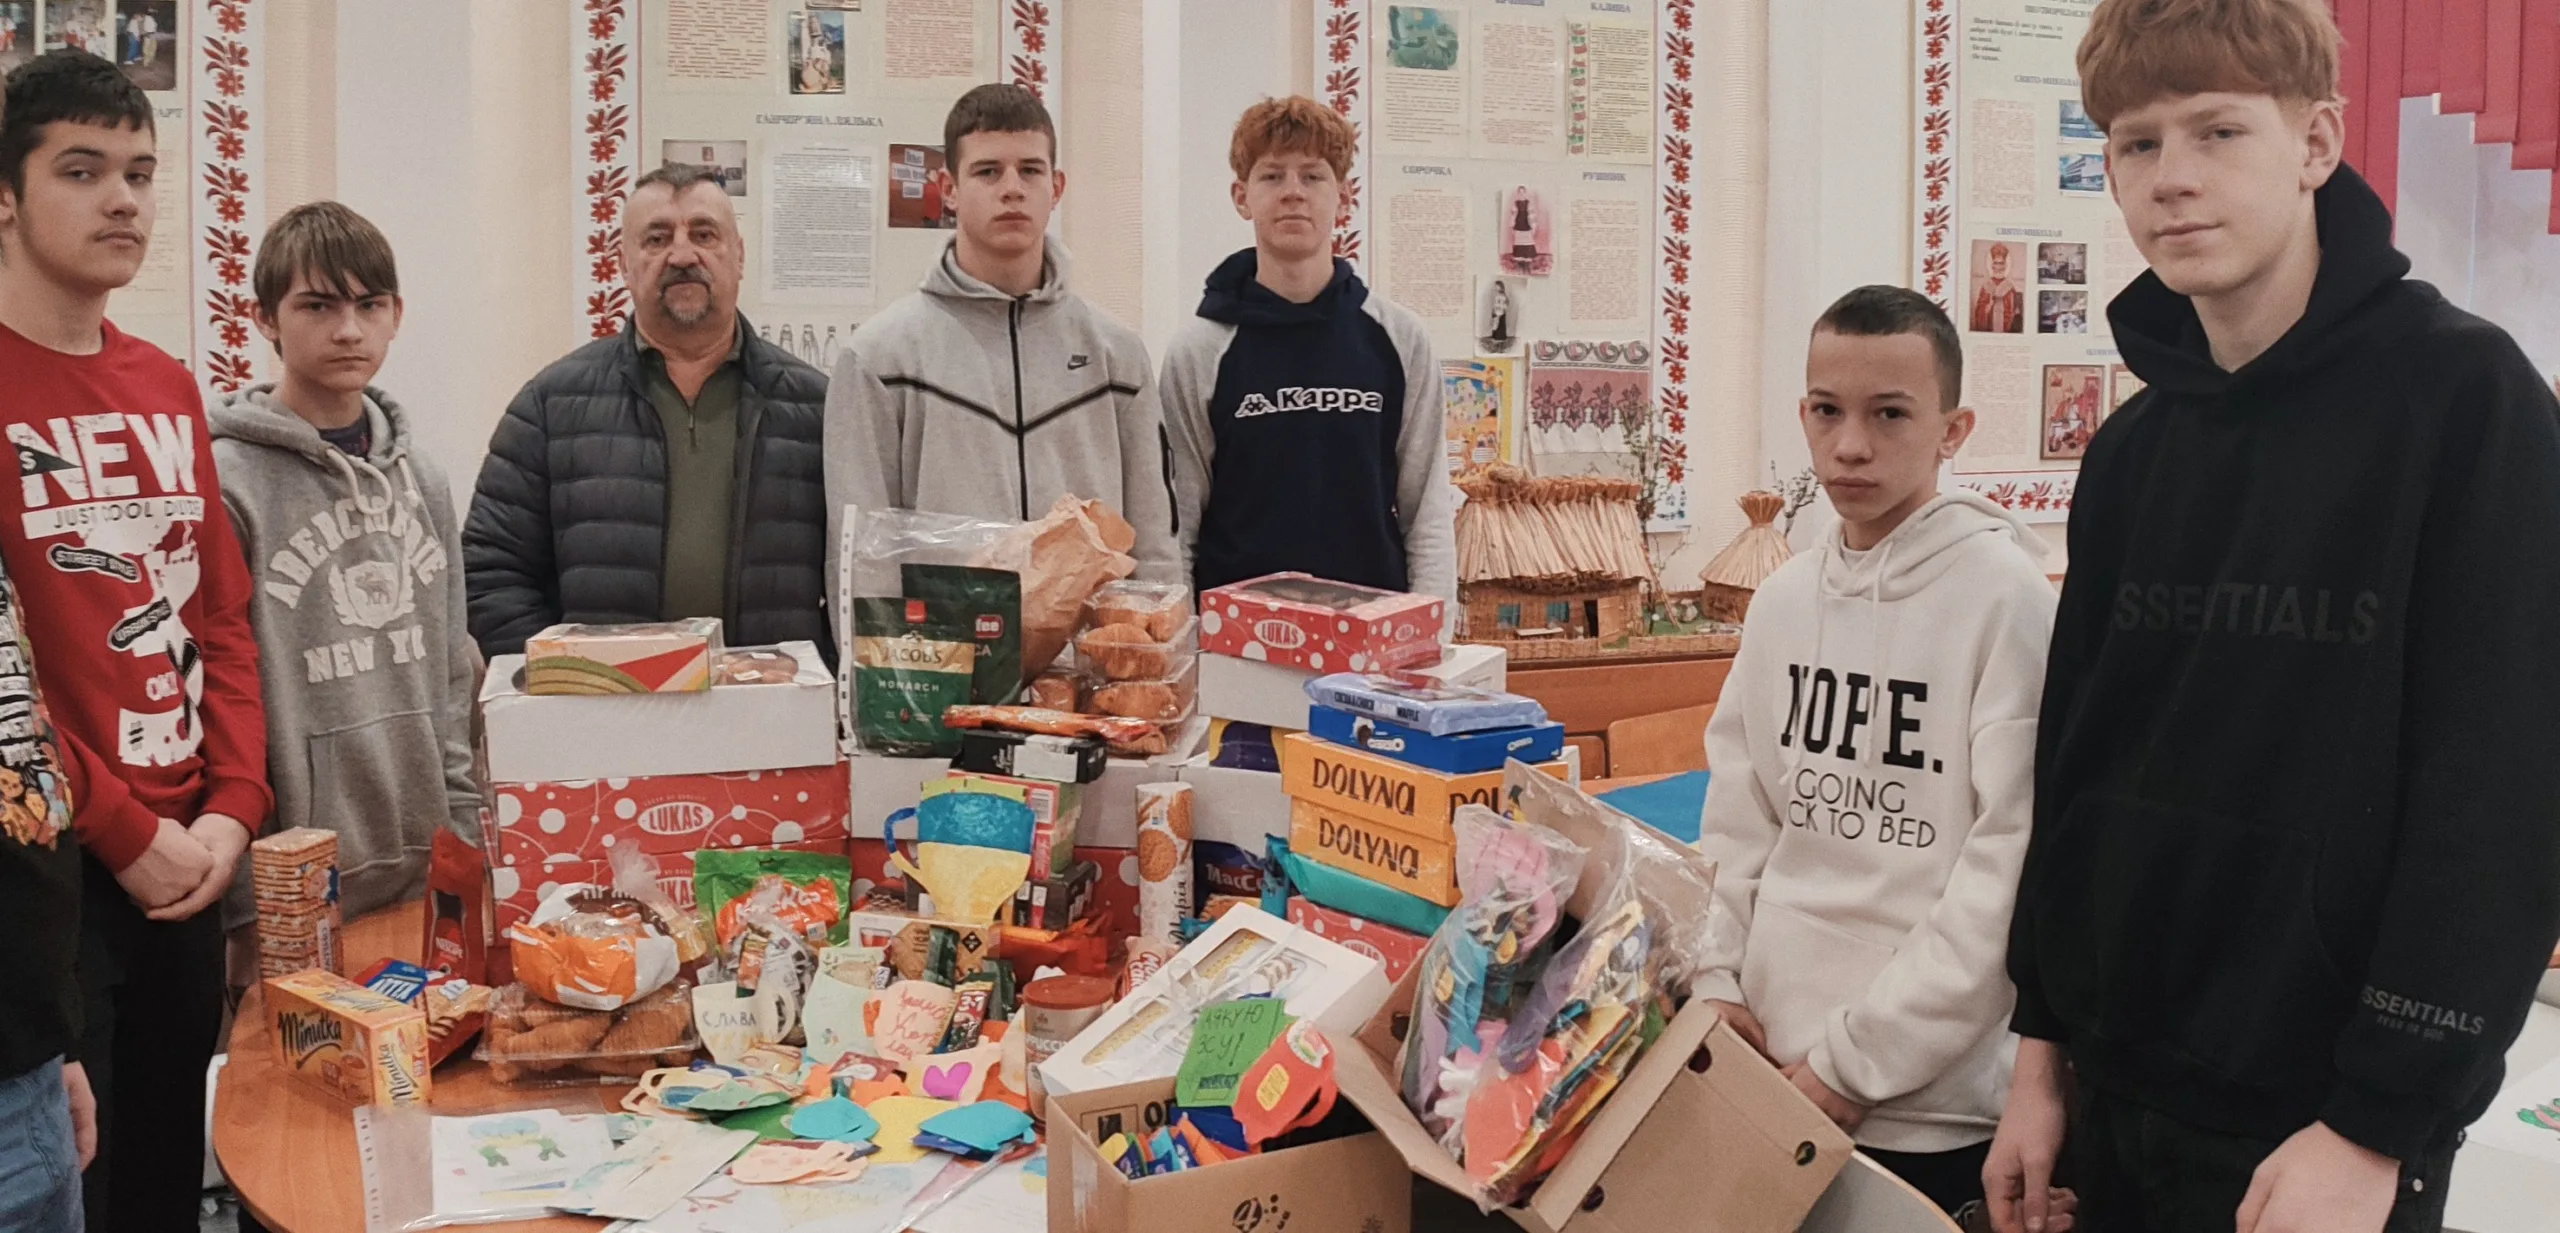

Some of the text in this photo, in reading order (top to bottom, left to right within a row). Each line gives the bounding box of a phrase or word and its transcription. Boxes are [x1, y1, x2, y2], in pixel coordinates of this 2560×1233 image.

[1277, 387, 1383, 412] Kappa
[6, 412, 197, 508] NEW
[1261, 622, 1299, 645] LUKAS
[2112, 580, 2382, 644] SSETIALS
[304, 635, 375, 684] NEW
[878, 679, 940, 692] MONARCH
[1795, 768, 1906, 813] GOING
[648, 804, 704, 832] LUKAS
[1788, 800, 1936, 848] CK TO BED
[2361, 984, 2485, 1035] SSENTIALS
[278, 1010, 343, 1066] Minutka
